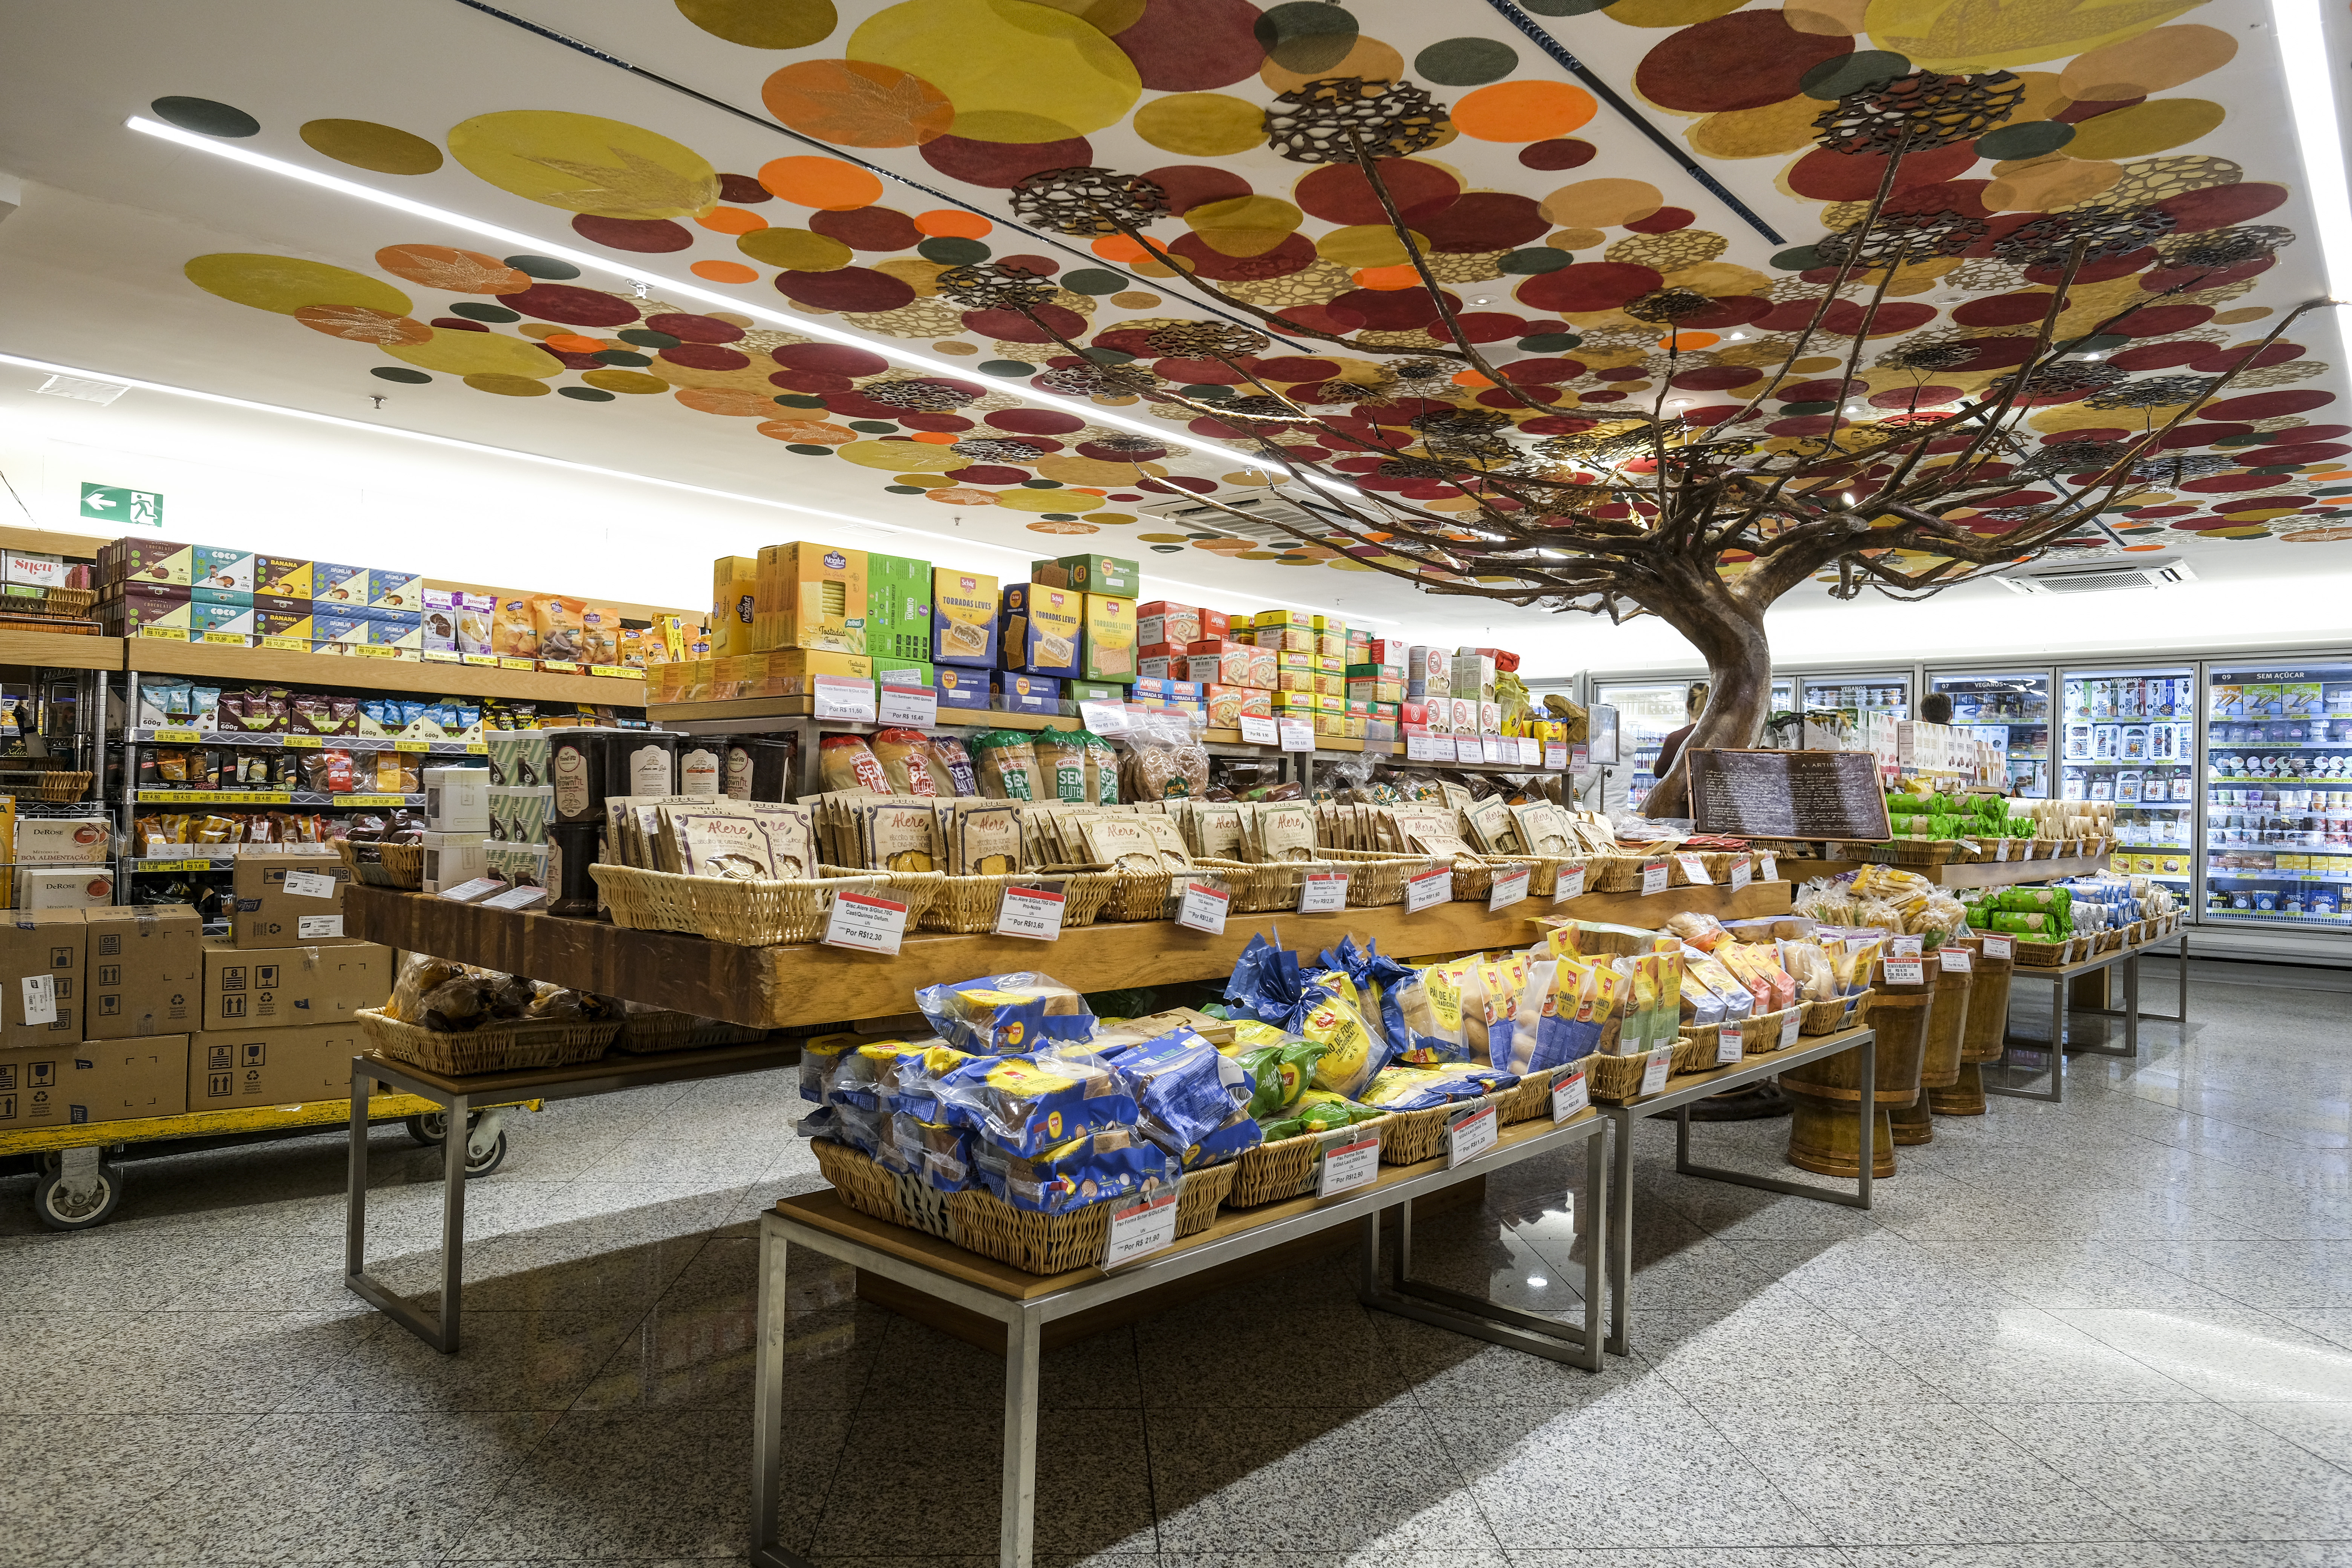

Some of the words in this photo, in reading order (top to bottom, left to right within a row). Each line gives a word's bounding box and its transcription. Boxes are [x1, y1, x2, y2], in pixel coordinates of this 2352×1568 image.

[270, 559, 297, 568] BANANA
[824, 556, 845, 565] Noglut
[961, 579, 975, 588] Schär
[943, 596, 974, 609] TORRADAS
[975, 600, 991, 610] LEVES
[1052, 595, 1063, 604] Schär
[742, 596, 752, 623] Noglut
[1036, 610, 1061, 620] TORRADAS
[1062, 615, 1076, 624] LEVES
[819, 626, 846, 636] Tostadas
[1094, 619, 1116, 629] TORRADAS
[1118, 622, 1132, 631] LEVES
[1059, 772, 1084, 785] SEM
[1059, 785, 1083, 798] GLÚTEN
[891, 813, 925, 828] Alere
[980, 816, 1005, 830] Alere
[1277, 814, 1300, 828] Alere
[707, 821, 748, 835] Alere
[1107, 824, 1136, 837] Alere
[846, 902, 868, 910] Bisc.Alere
[869, 907, 893, 916] S/Glut.70G
[846, 910, 873, 919] Cast/Quinoa
[1024, 920, 1044, 929] R$13,60
[845, 928, 857, 936] Por
[859, 930, 882, 941] R$12,30
[1471, 1137, 1485, 1148] R$11,20
[1346, 1171, 1363, 1181] R$12,90
[1124, 1243, 1134, 1251] Por
[1145, 1233, 1159, 1243] 21,90
